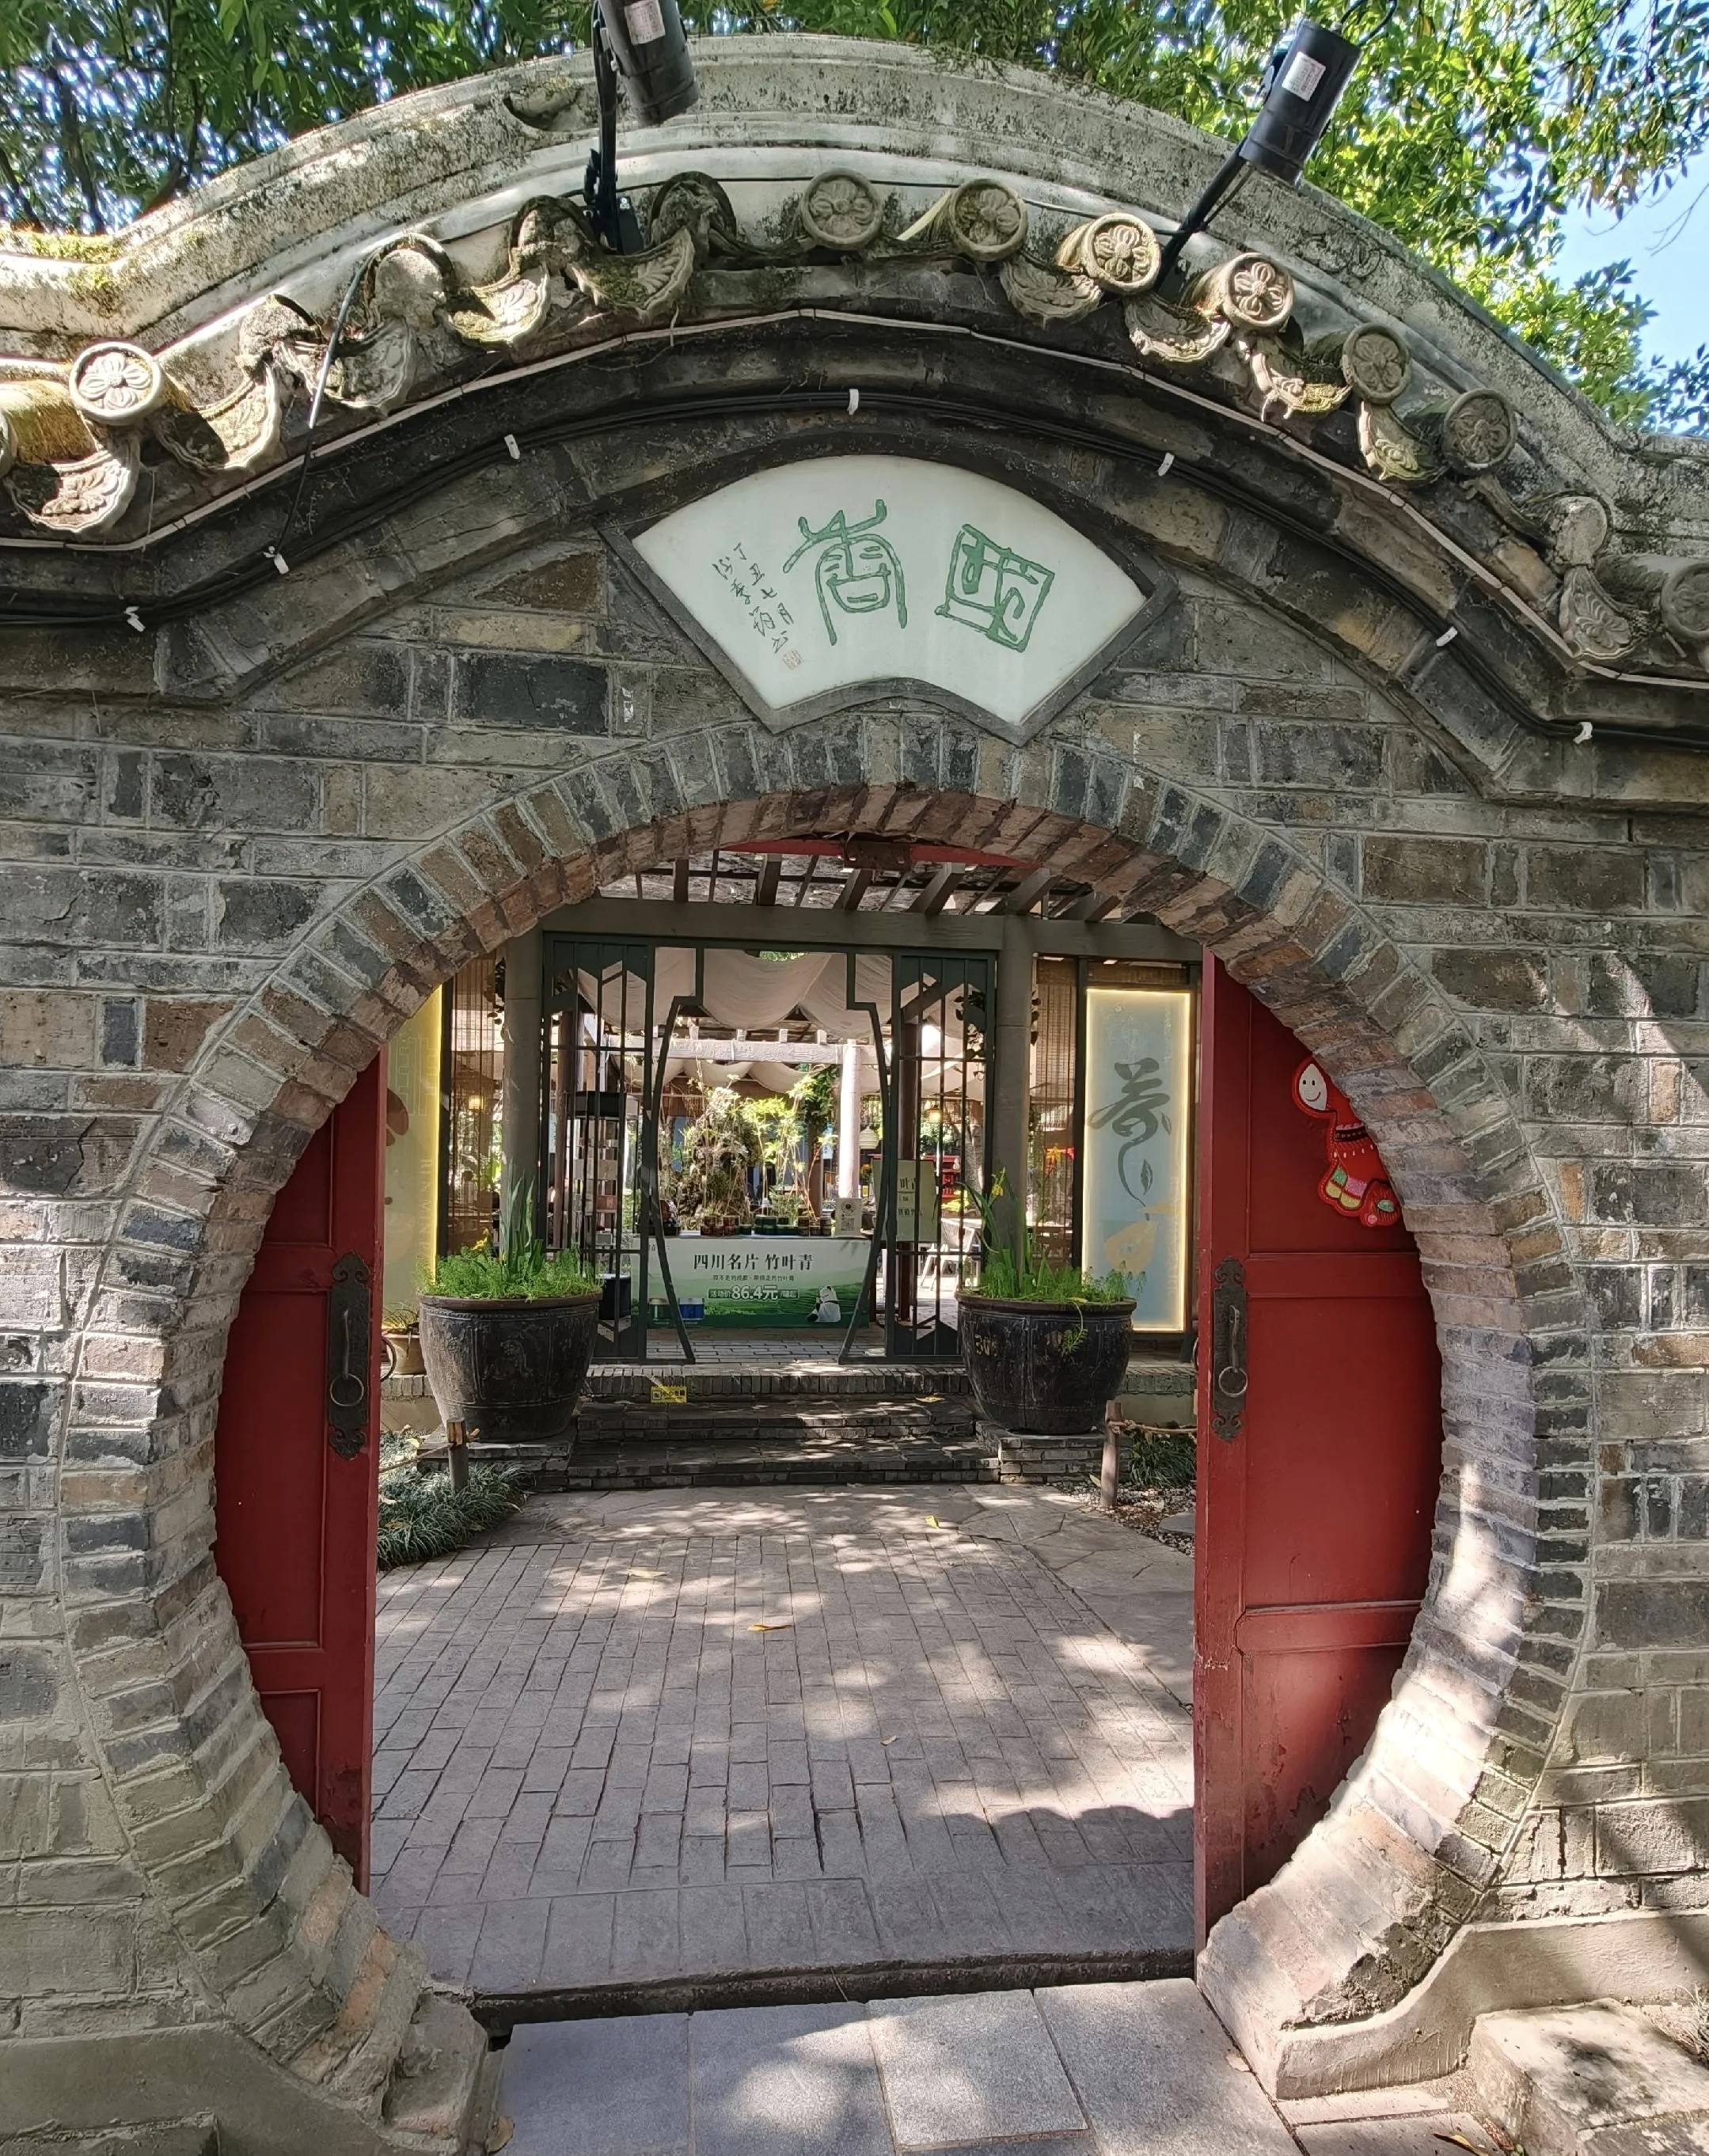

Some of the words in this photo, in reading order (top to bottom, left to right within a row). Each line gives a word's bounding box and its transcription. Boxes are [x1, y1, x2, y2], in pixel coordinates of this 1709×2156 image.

[693, 1253, 759, 1270] 四川名片
[765, 1253, 813, 1271] 竹叶青
